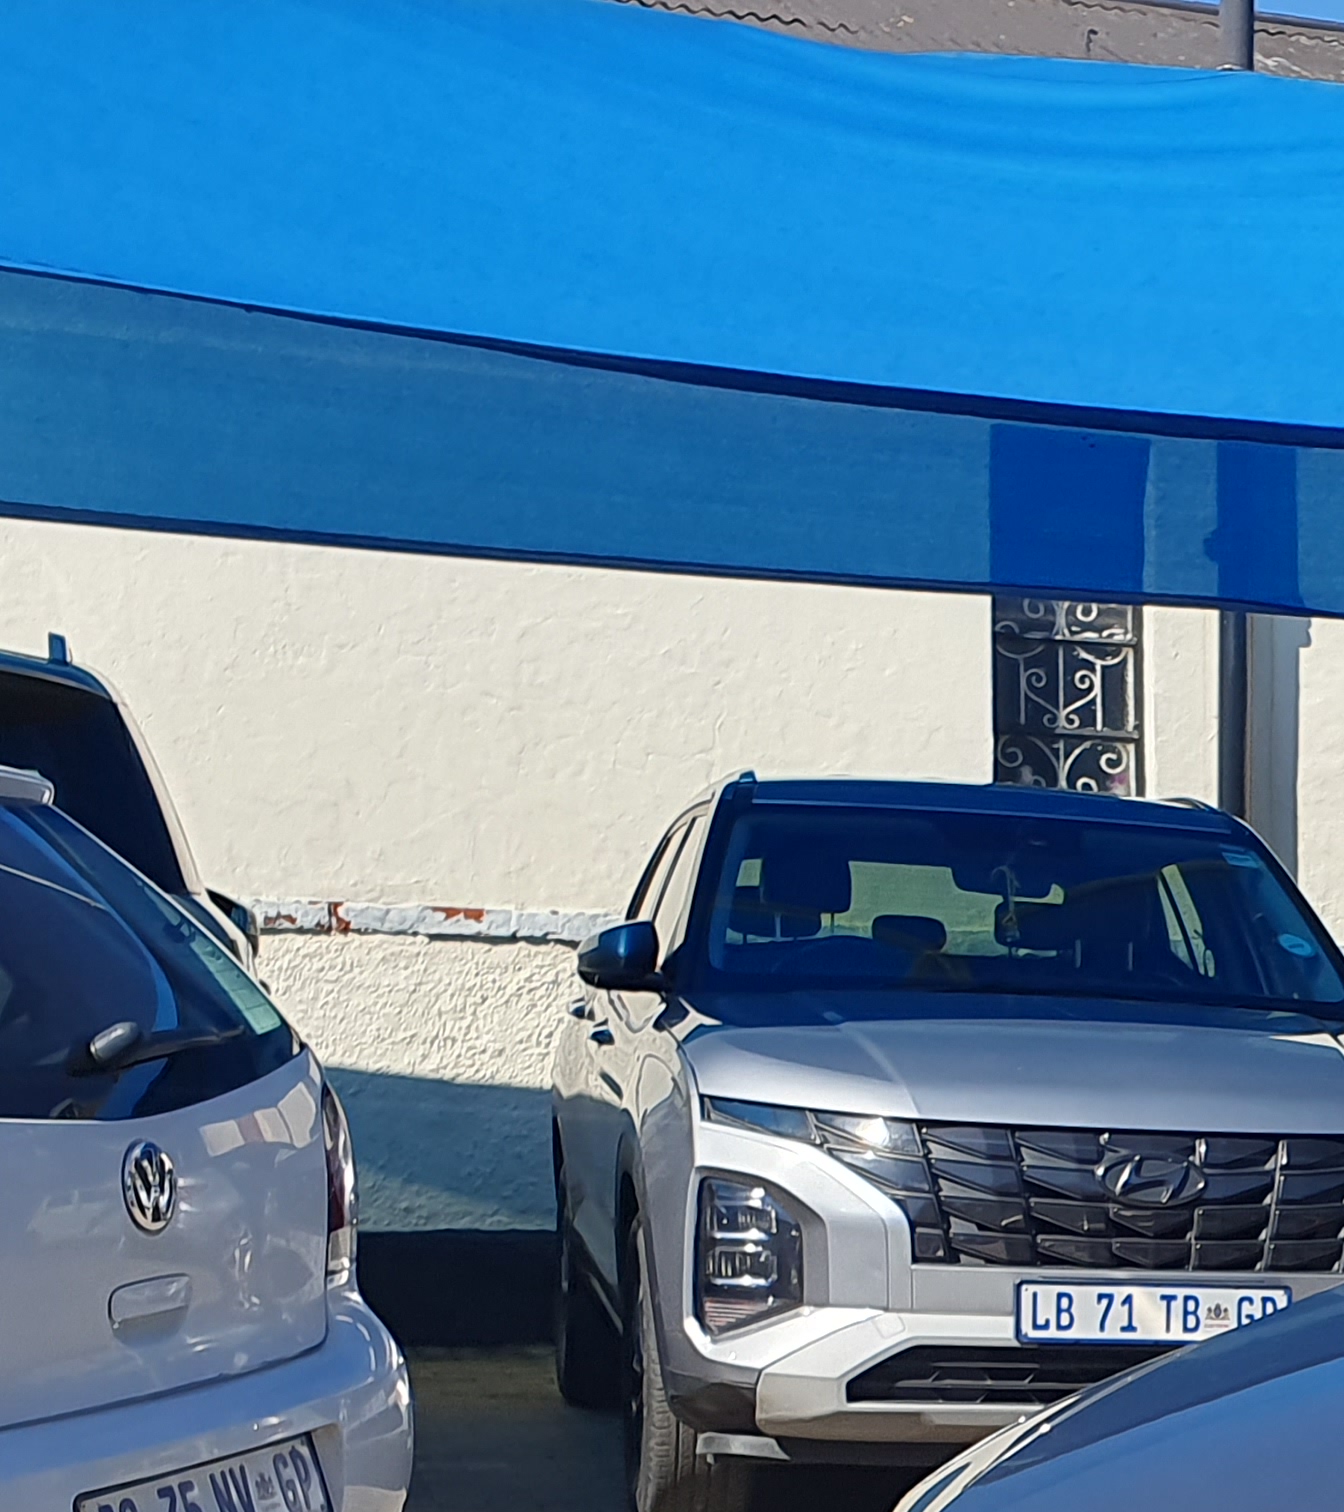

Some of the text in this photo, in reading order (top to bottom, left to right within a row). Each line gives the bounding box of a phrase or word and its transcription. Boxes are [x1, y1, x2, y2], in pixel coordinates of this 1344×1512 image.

[1031, 1290, 1075, 1332] LB
[1096, 1292, 1139, 1334] 71
[1159, 1294, 1201, 1335] TB
